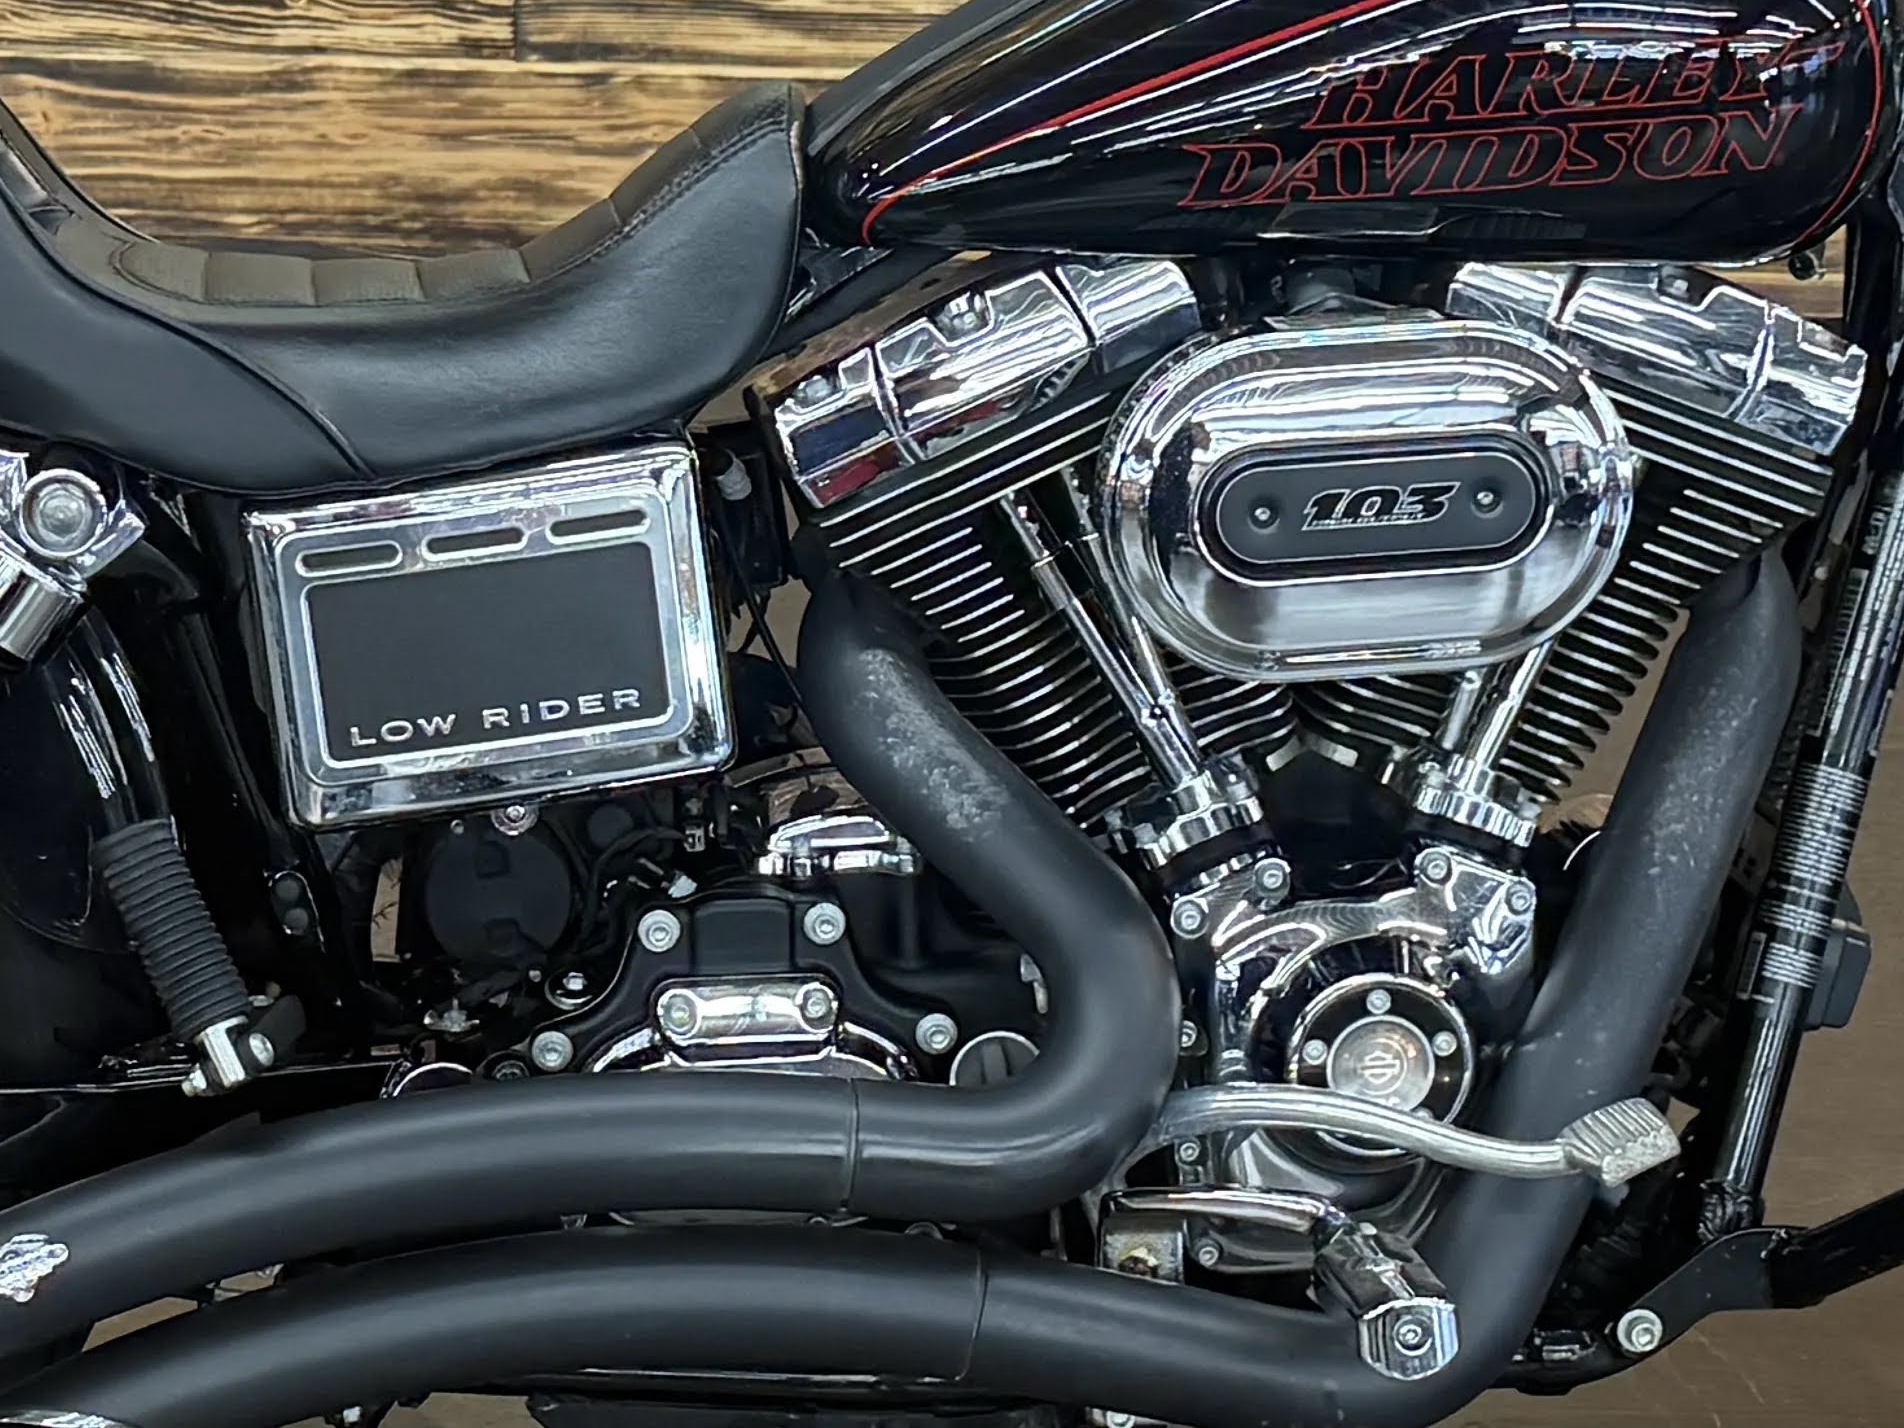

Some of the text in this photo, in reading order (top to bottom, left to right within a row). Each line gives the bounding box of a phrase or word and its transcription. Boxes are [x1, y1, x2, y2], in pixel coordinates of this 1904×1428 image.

[1176, 103, 1803, 209] DAVIDSON
[1301, 481, 1463, 530] 103
[349, 687, 642, 747] LOW RIDER
